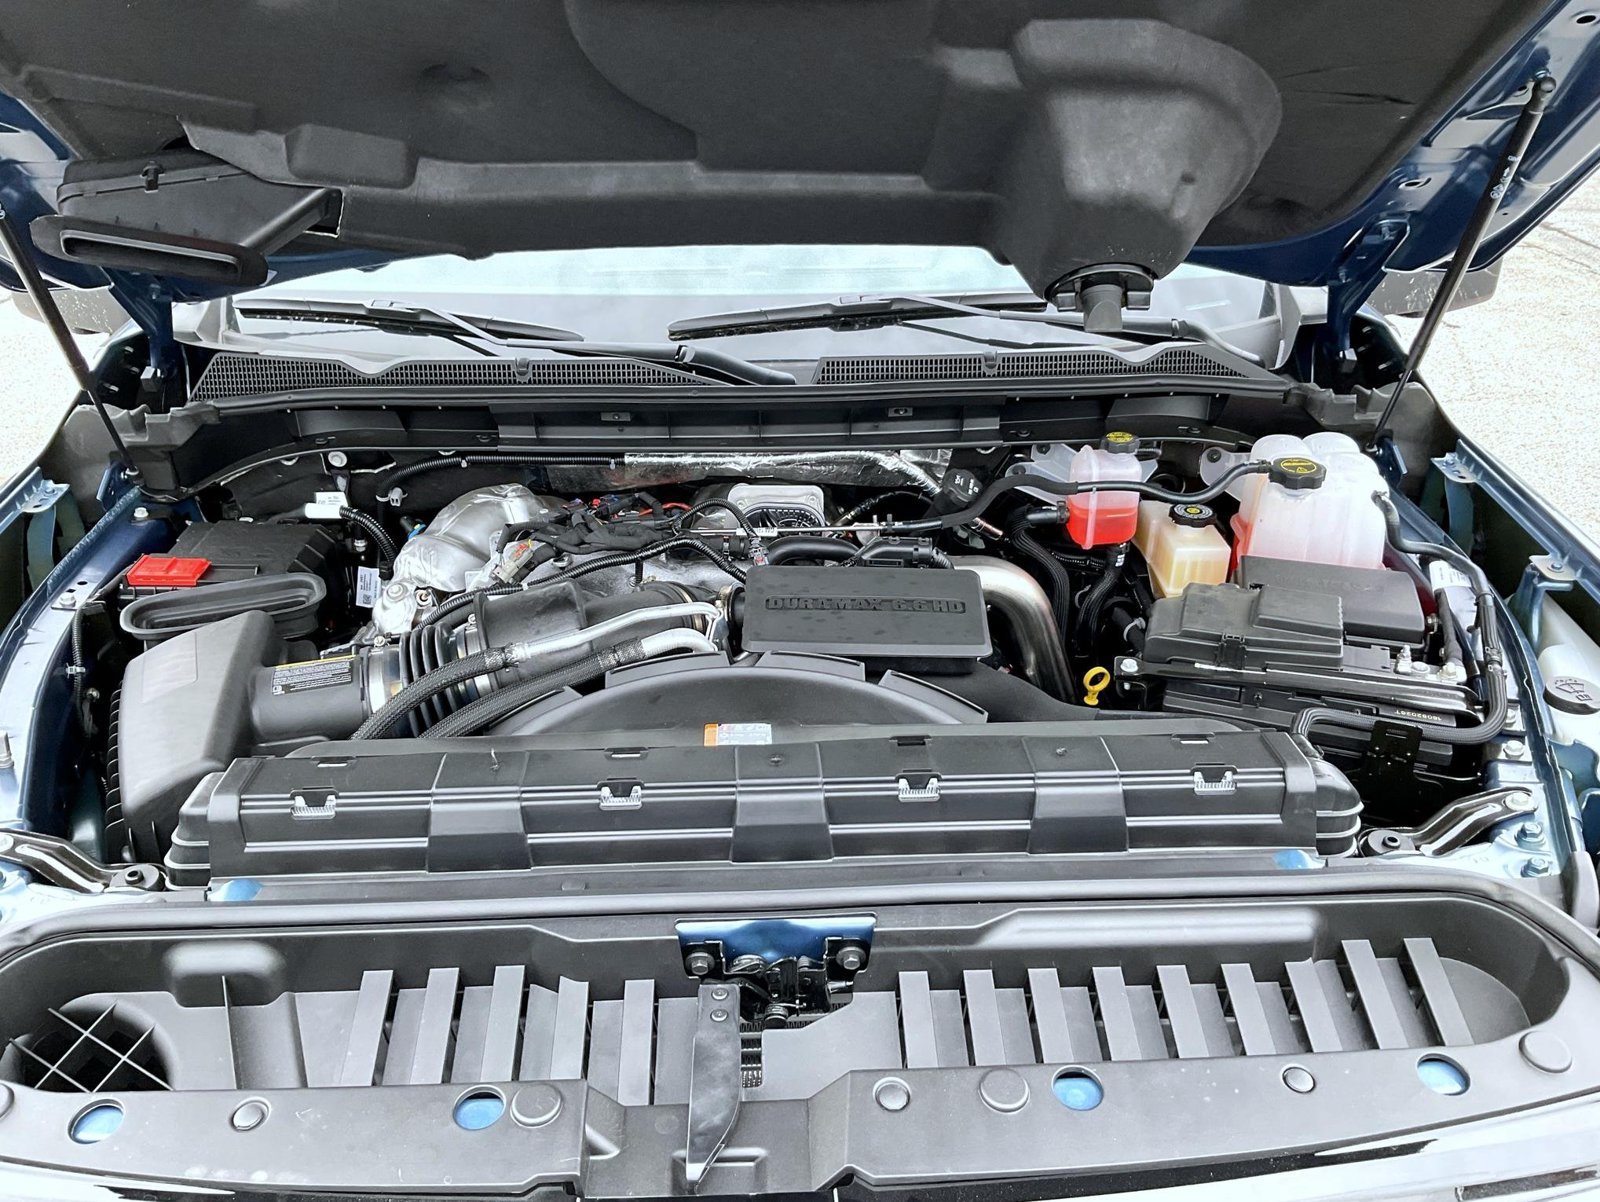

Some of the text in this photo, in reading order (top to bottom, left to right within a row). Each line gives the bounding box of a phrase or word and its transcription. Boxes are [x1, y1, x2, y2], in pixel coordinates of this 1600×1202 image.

[766, 597, 965, 613] DURAMAX 6.6 HD
